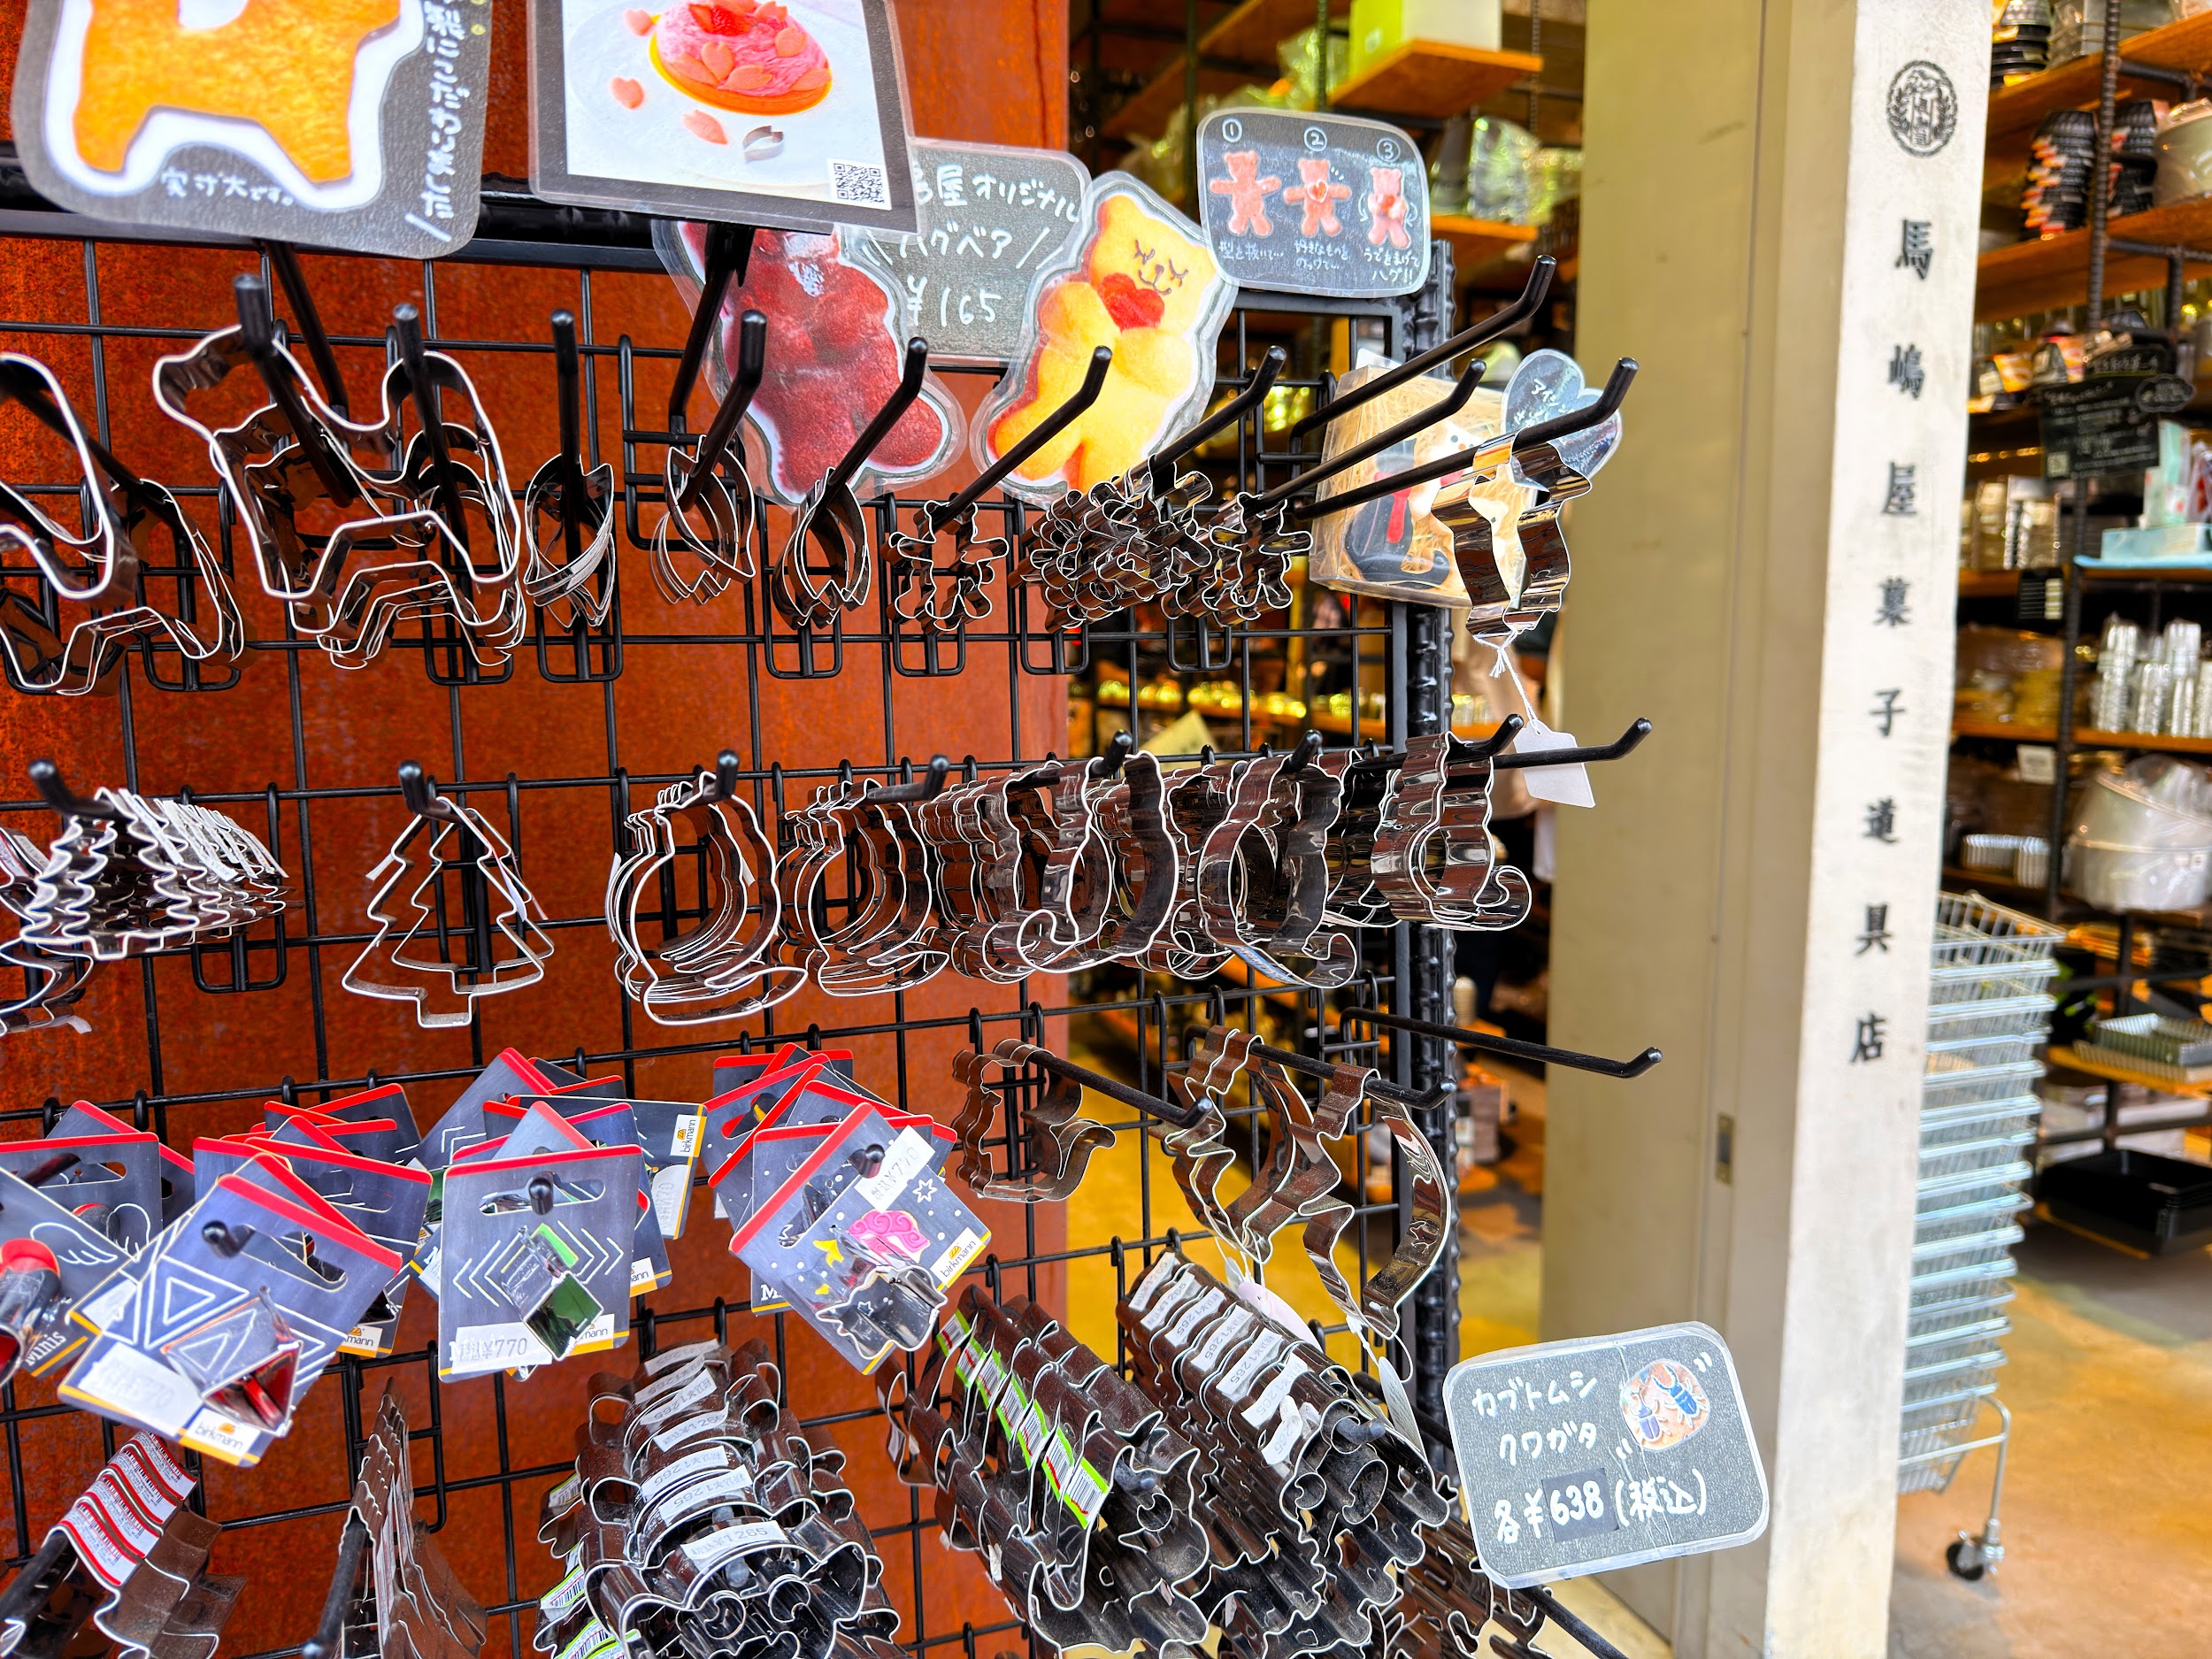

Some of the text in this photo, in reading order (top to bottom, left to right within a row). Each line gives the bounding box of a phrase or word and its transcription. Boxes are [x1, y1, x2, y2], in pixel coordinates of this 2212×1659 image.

[420, 0, 471, 219] にこだわりました
[906, 273, 1002, 327] ¥165
[680, 1119, 696, 1153] birkmann
[940, 1240, 978, 1279] birkmann
[1472, 1371, 1598, 1418] カブトムシ
[194, 1421, 244, 1452] birkmann
[1499, 1420, 1598, 1466] クワガタ
